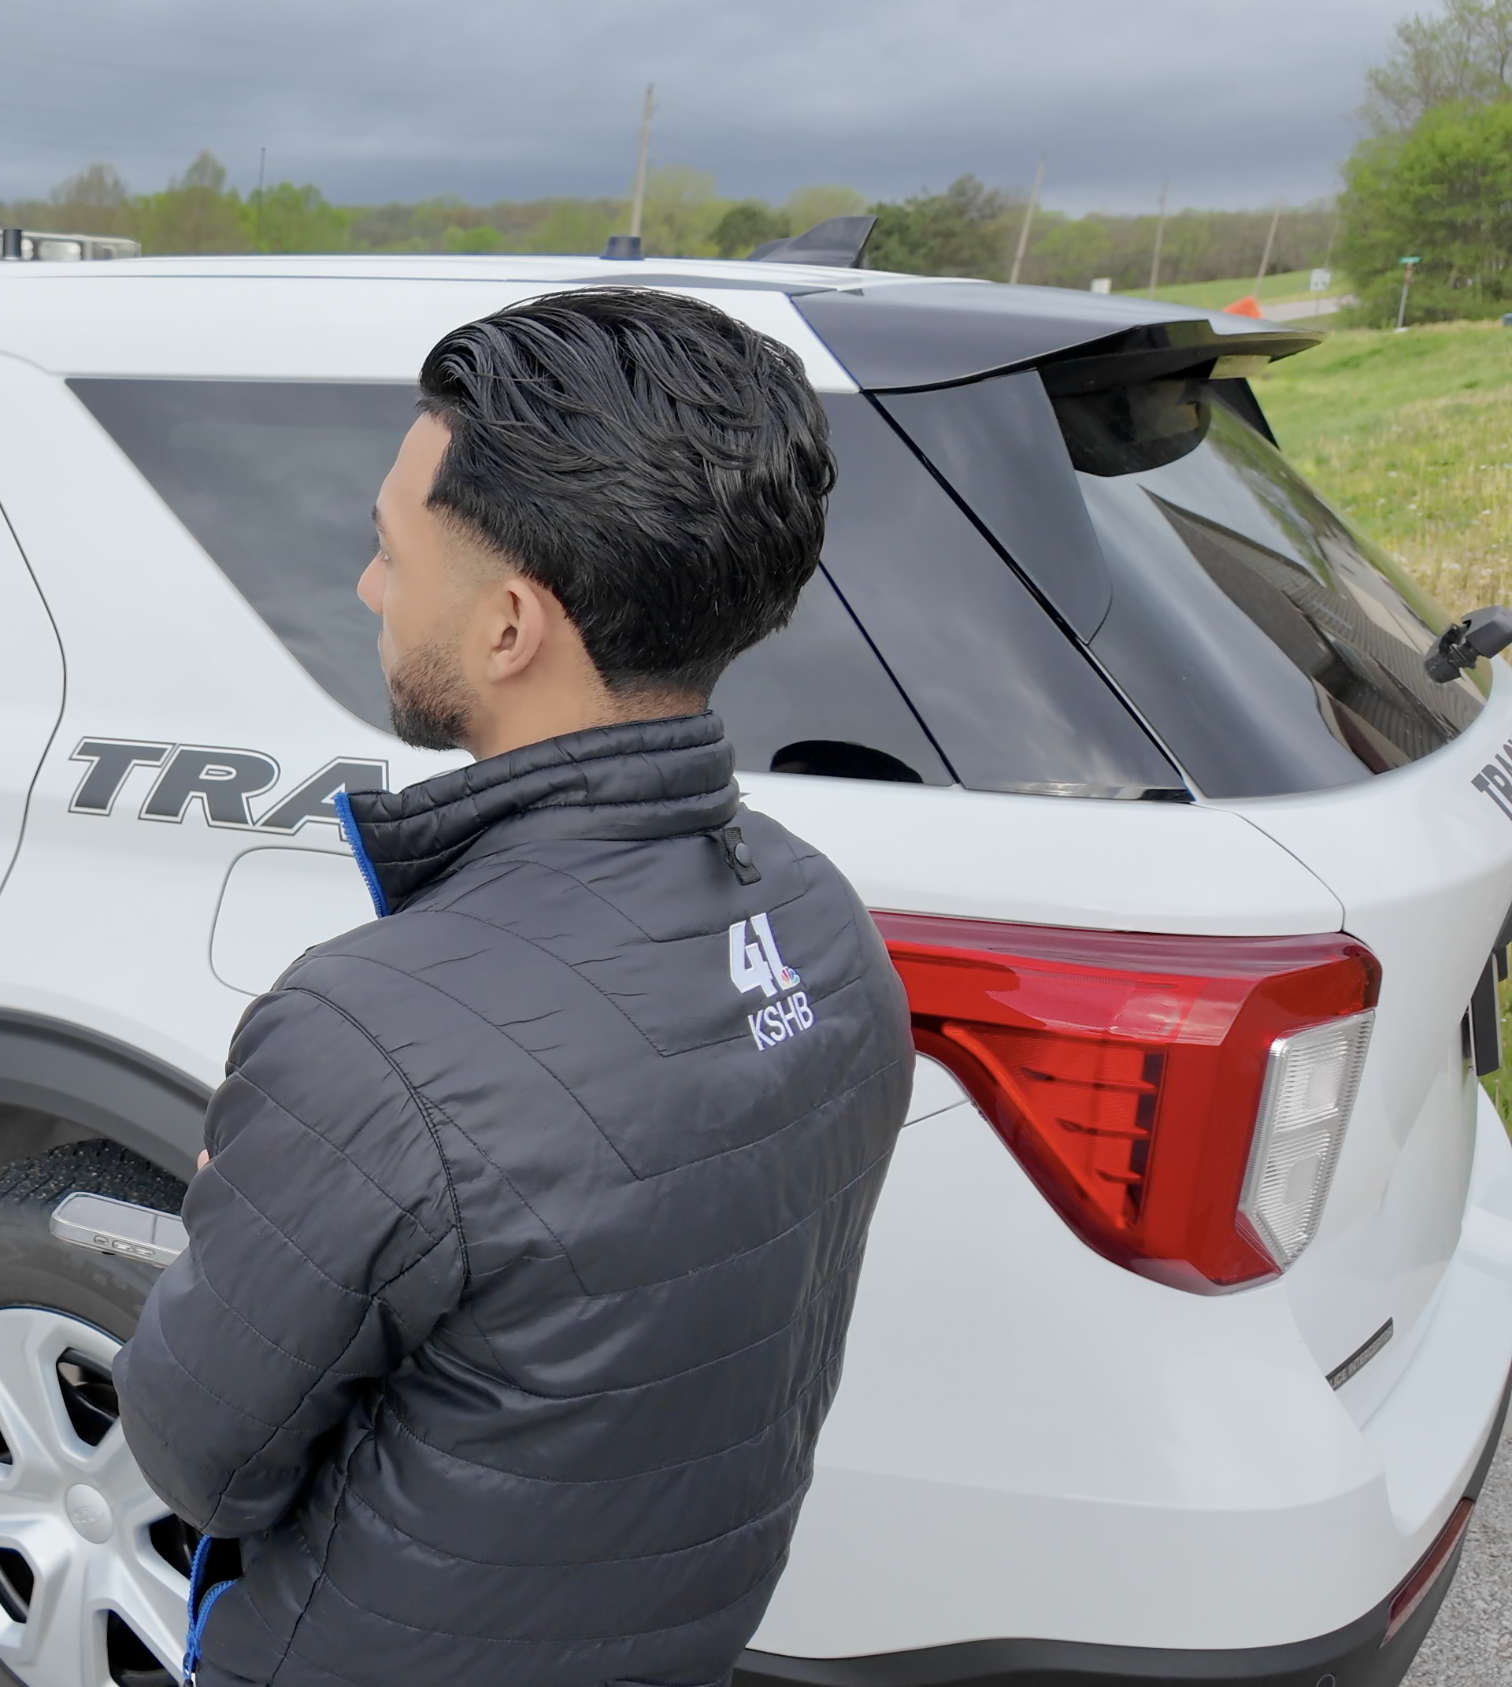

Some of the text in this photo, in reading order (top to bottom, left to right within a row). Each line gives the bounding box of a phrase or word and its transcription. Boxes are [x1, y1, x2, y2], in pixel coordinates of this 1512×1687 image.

[68, 736, 389, 842] TRA
[729, 912, 801, 998] 41
[748, 991, 814, 1051] KSHB
